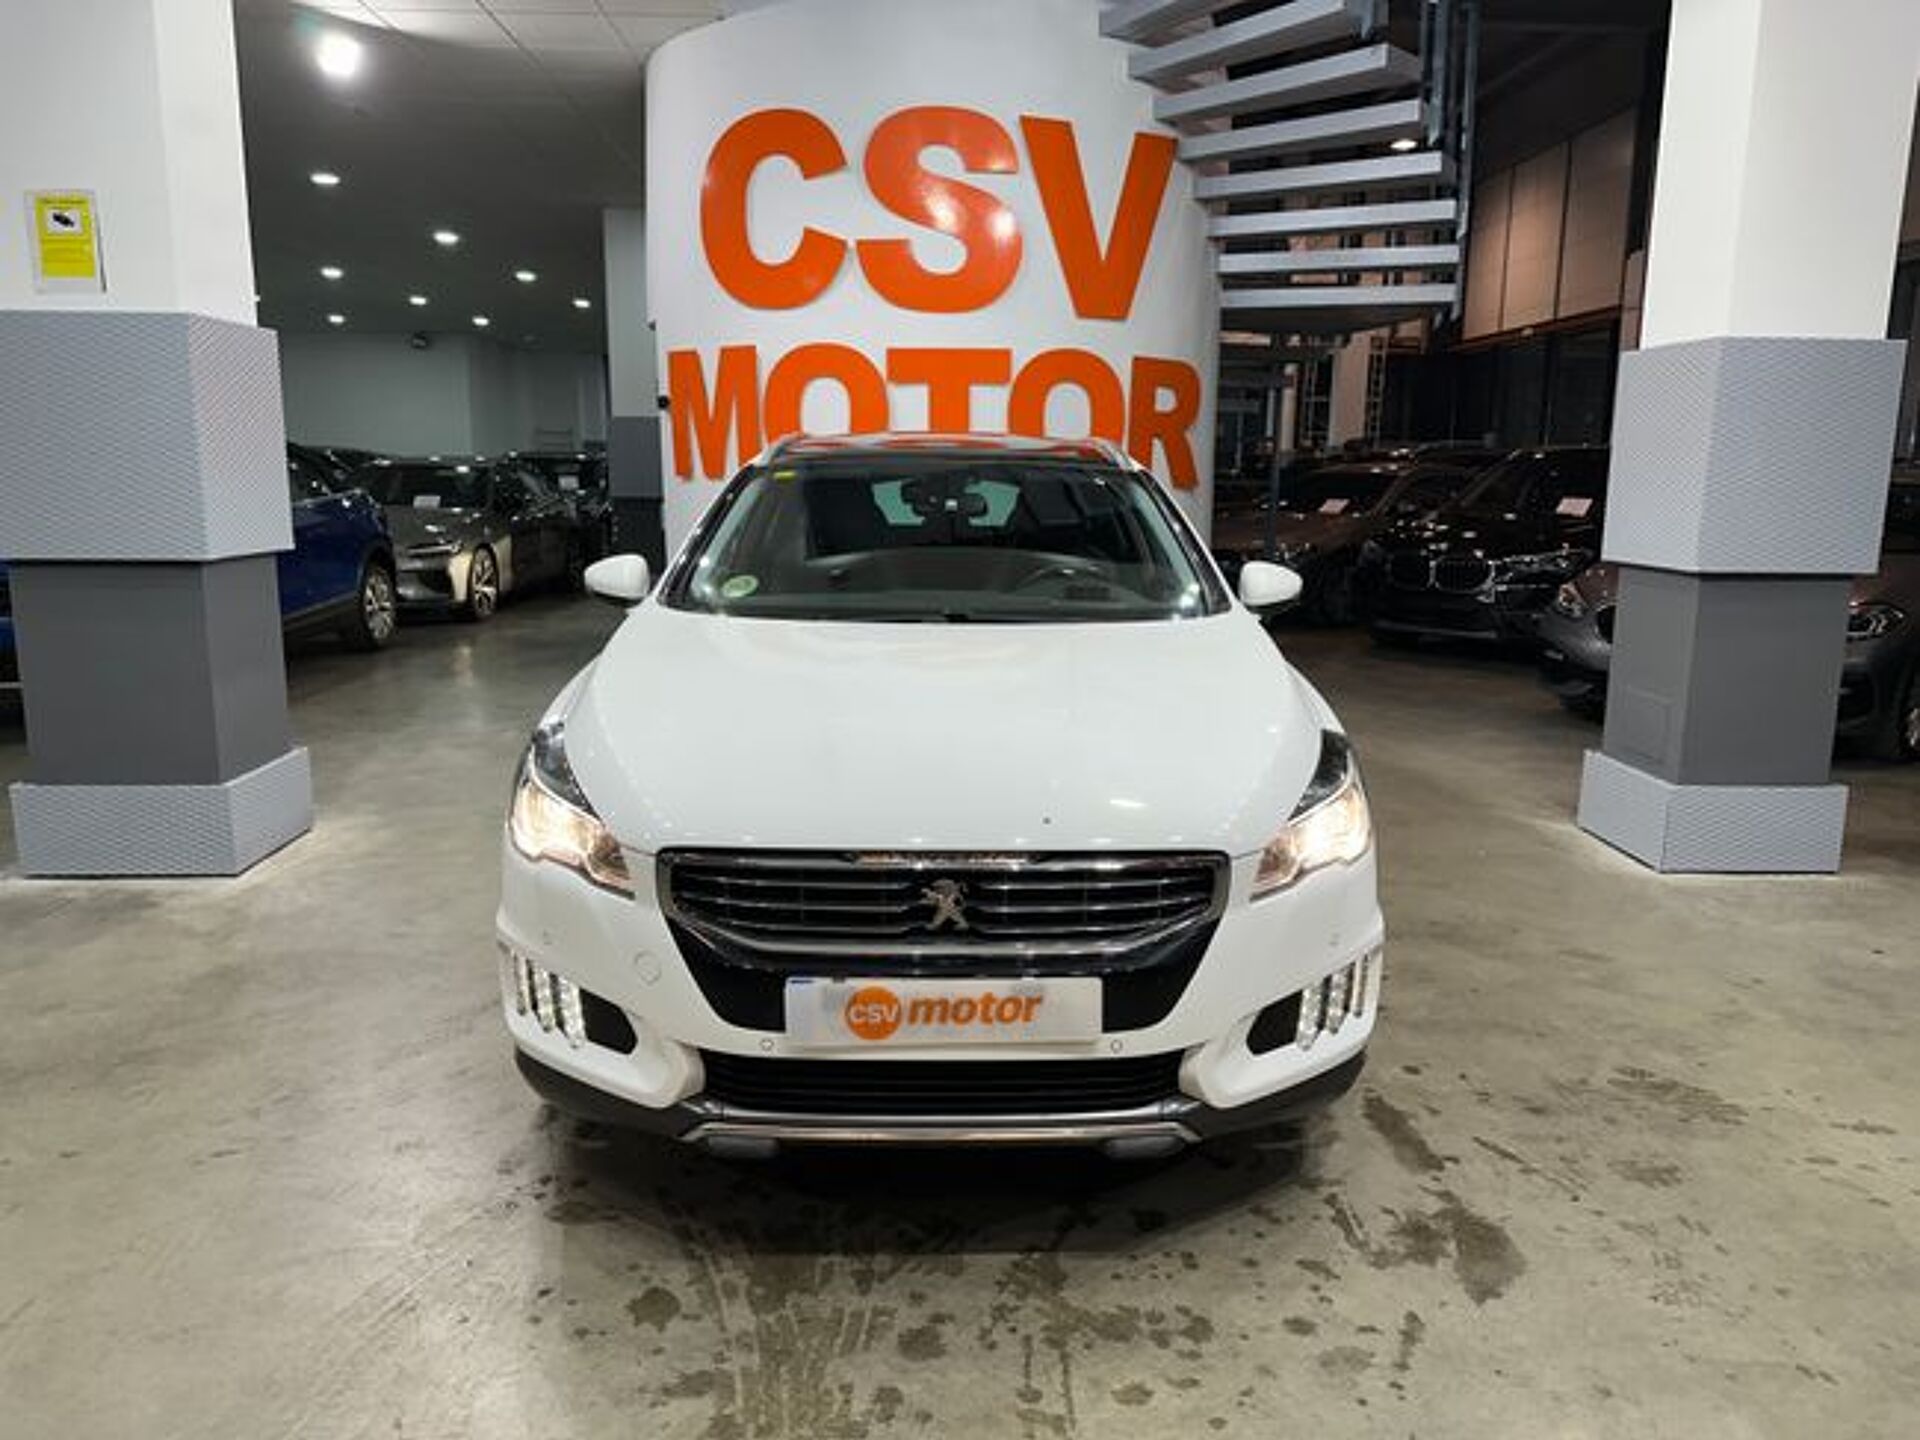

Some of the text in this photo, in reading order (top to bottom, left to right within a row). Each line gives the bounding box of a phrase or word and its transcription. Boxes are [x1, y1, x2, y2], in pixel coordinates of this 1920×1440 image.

[700, 105, 1178, 320] CSV
[667, 342, 1201, 490] MOTOR
[908, 992, 1043, 1026] motor
